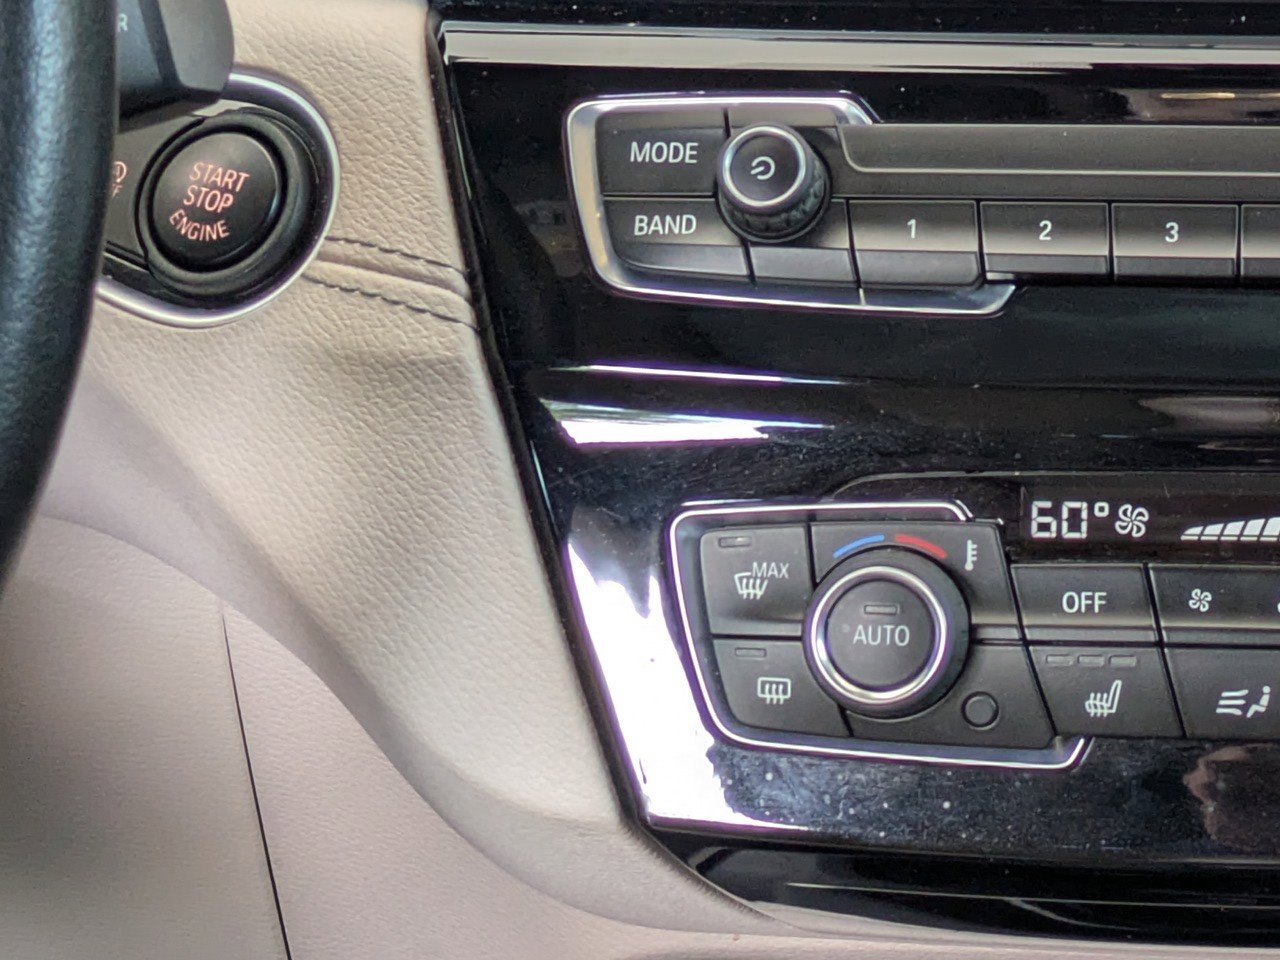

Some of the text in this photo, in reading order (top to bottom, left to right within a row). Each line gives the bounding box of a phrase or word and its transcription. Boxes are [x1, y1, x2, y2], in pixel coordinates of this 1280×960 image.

[631, 142, 698, 163] MODE
[189, 162, 249, 192] START
[183, 185, 233, 213] STOP
[169, 208, 229, 241] ENGINE
[634, 214, 697, 236] BAND
[907, 219, 917, 240] 1
[1039, 221, 1053, 242] 2
[1164, 222, 1179, 244] 3
[752, 562, 789, 579] MAX
[1062, 592, 1106, 613] OFF
[853, 624, 910, 646] AUTO
